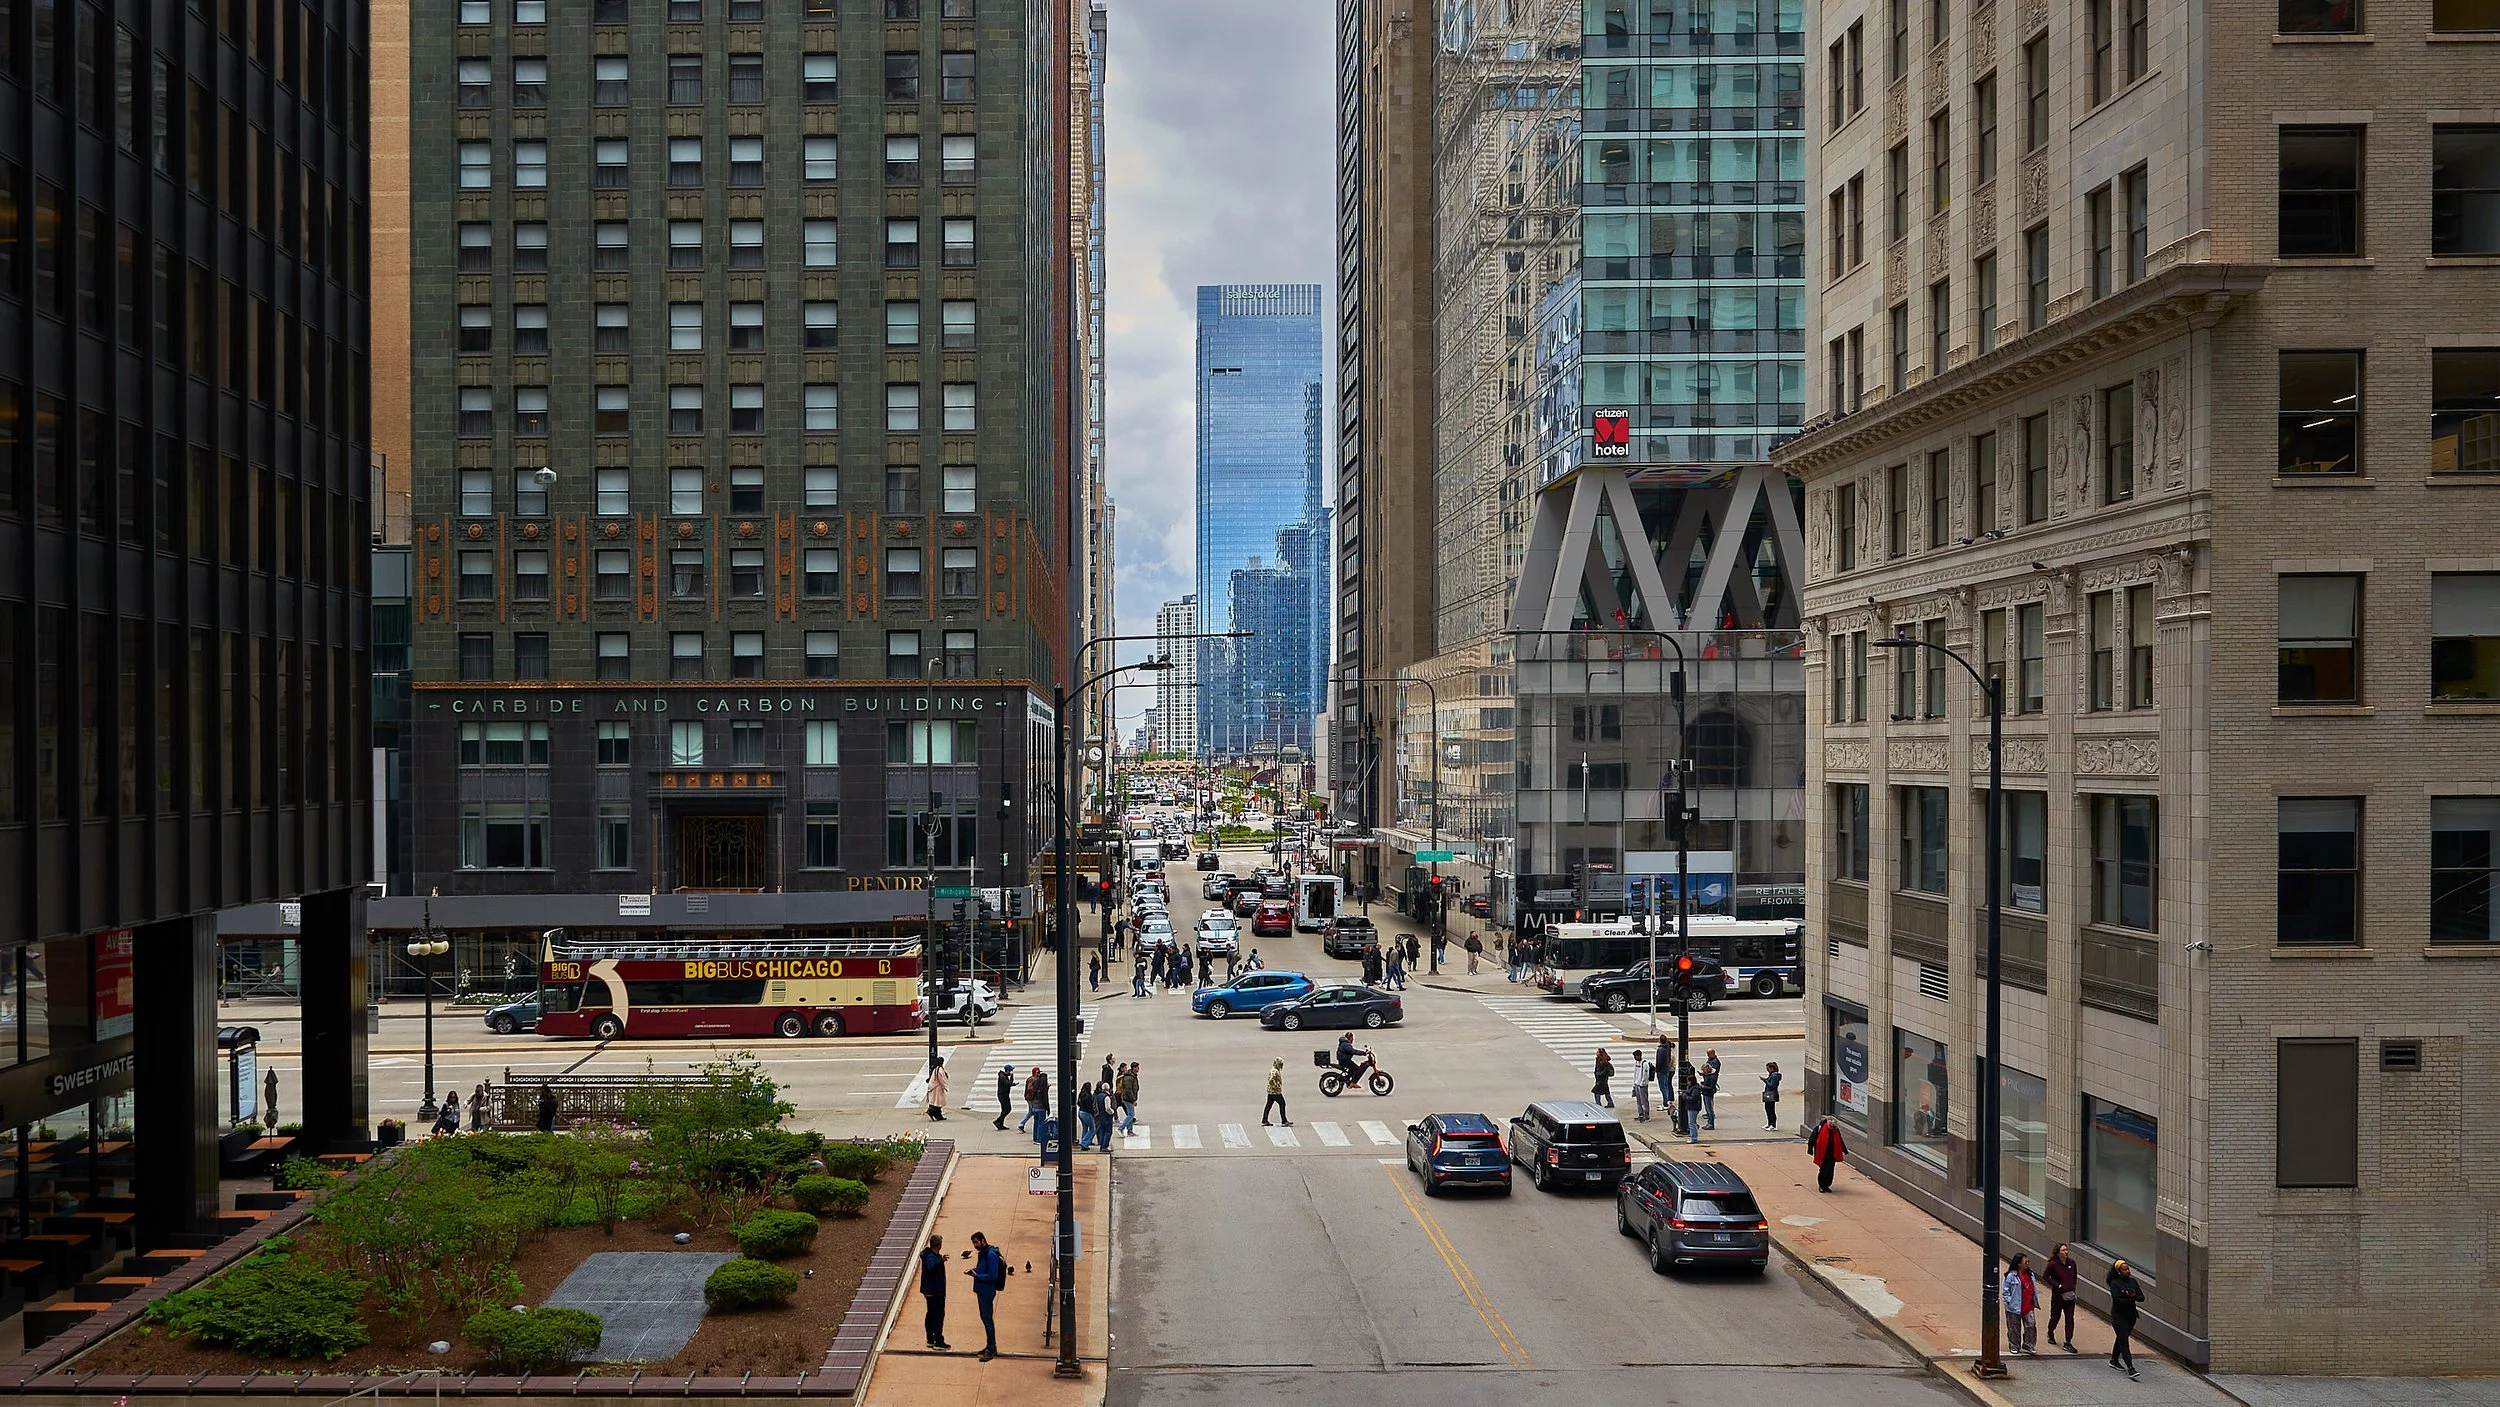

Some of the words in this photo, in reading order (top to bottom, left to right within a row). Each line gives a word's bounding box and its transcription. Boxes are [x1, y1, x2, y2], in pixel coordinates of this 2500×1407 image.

[1227, 288, 1280, 302] salesforce
[1595, 408, 1629, 418] citizen
[1595, 443, 1629, 456] hotel
[452, 700, 582, 713] CARBIDE
[615, 699, 668, 712] AND
[697, 698, 815, 712] CARBON
[845, 697, 984, 711] BUILDING
[940, 888, 965, 897] Michigan
[1755, 887, 1794, 896] RETAIL
[1760, 897, 1793, 905] FROM
[1524, 913, 1616, 929] MILIE
[552, 963, 568, 972] BIG
[755, 960, 843, 978] CHICAGO
[552, 972, 568, 980] BUS
[53, 1055, 134, 1096] SWEETWATE
[2007, 1077, 2020, 1092] PNC
